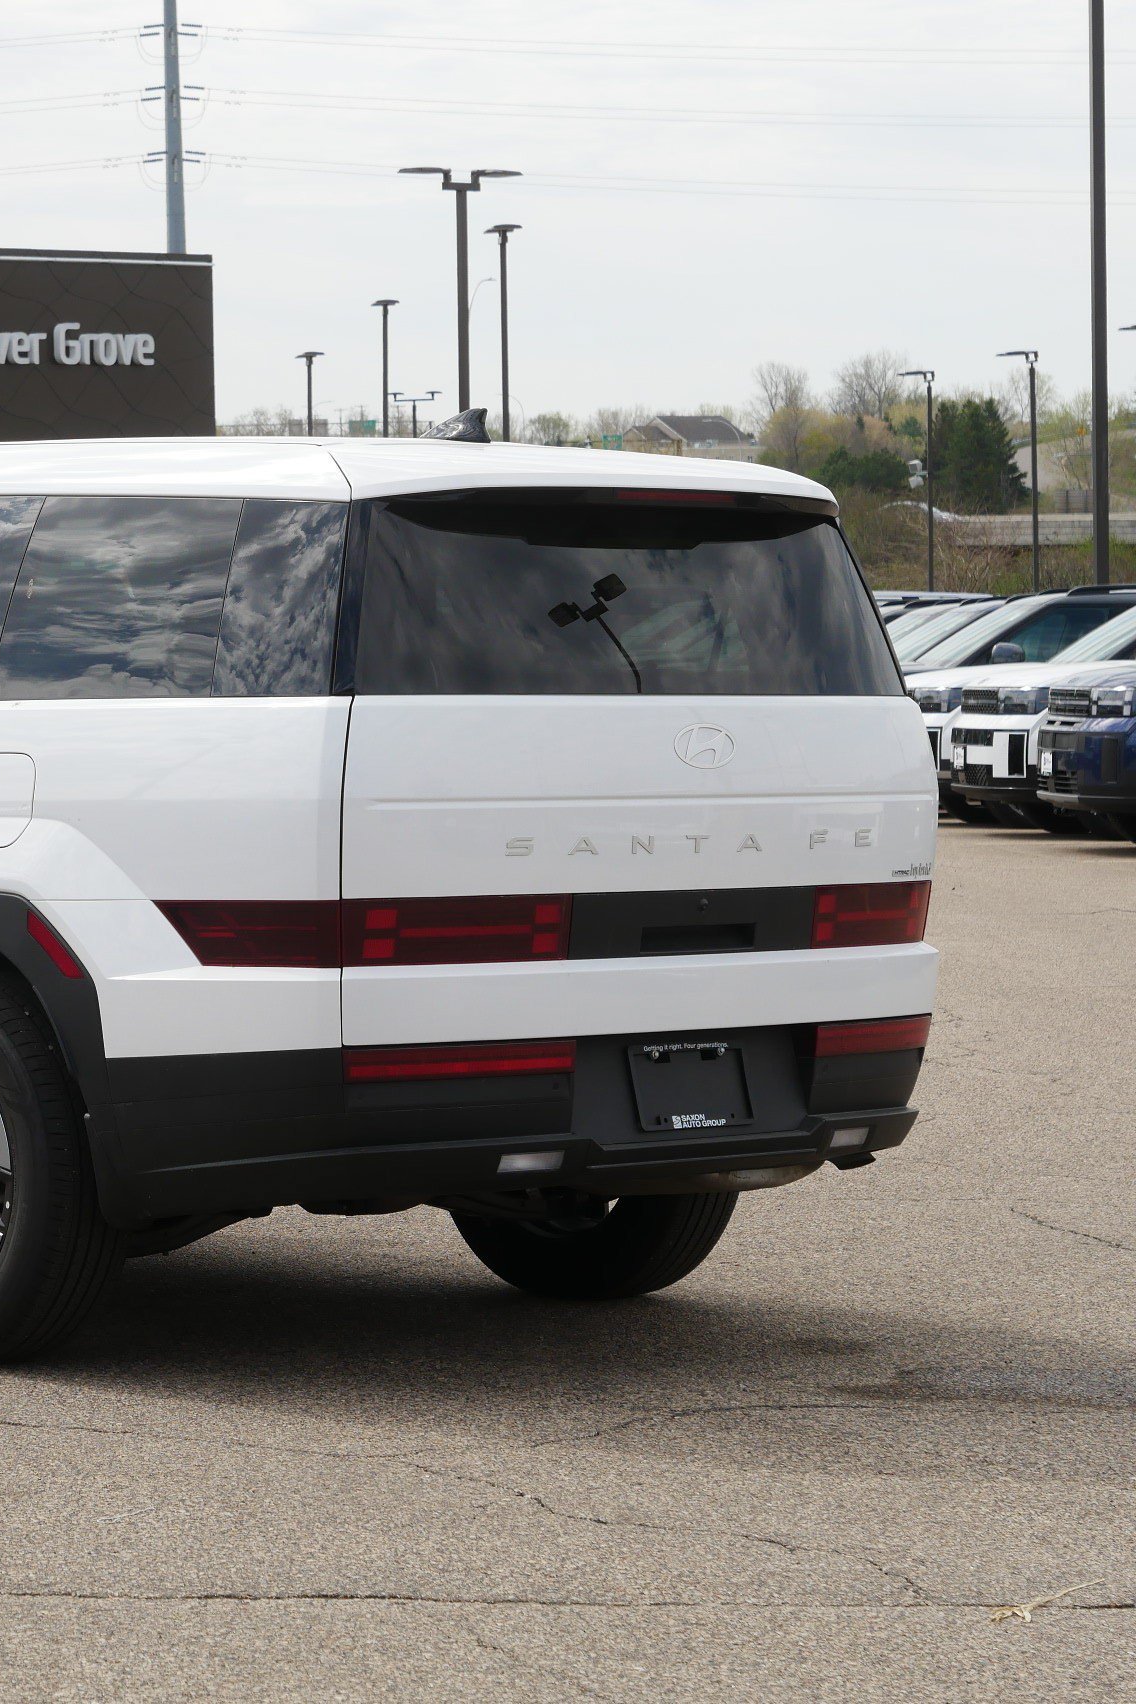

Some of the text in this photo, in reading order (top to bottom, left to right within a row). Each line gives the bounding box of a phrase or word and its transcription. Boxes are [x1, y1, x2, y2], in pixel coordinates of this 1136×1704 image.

[53, 322, 155, 366] Grove
[505, 828, 872, 857] SANTA FE
[668, 1043, 683, 1051] right.
[697, 1042, 728, 1050] generations.
[681, 1113, 705, 1121] SAXON
[683, 1119, 726, 1128] AUTO GROUP
